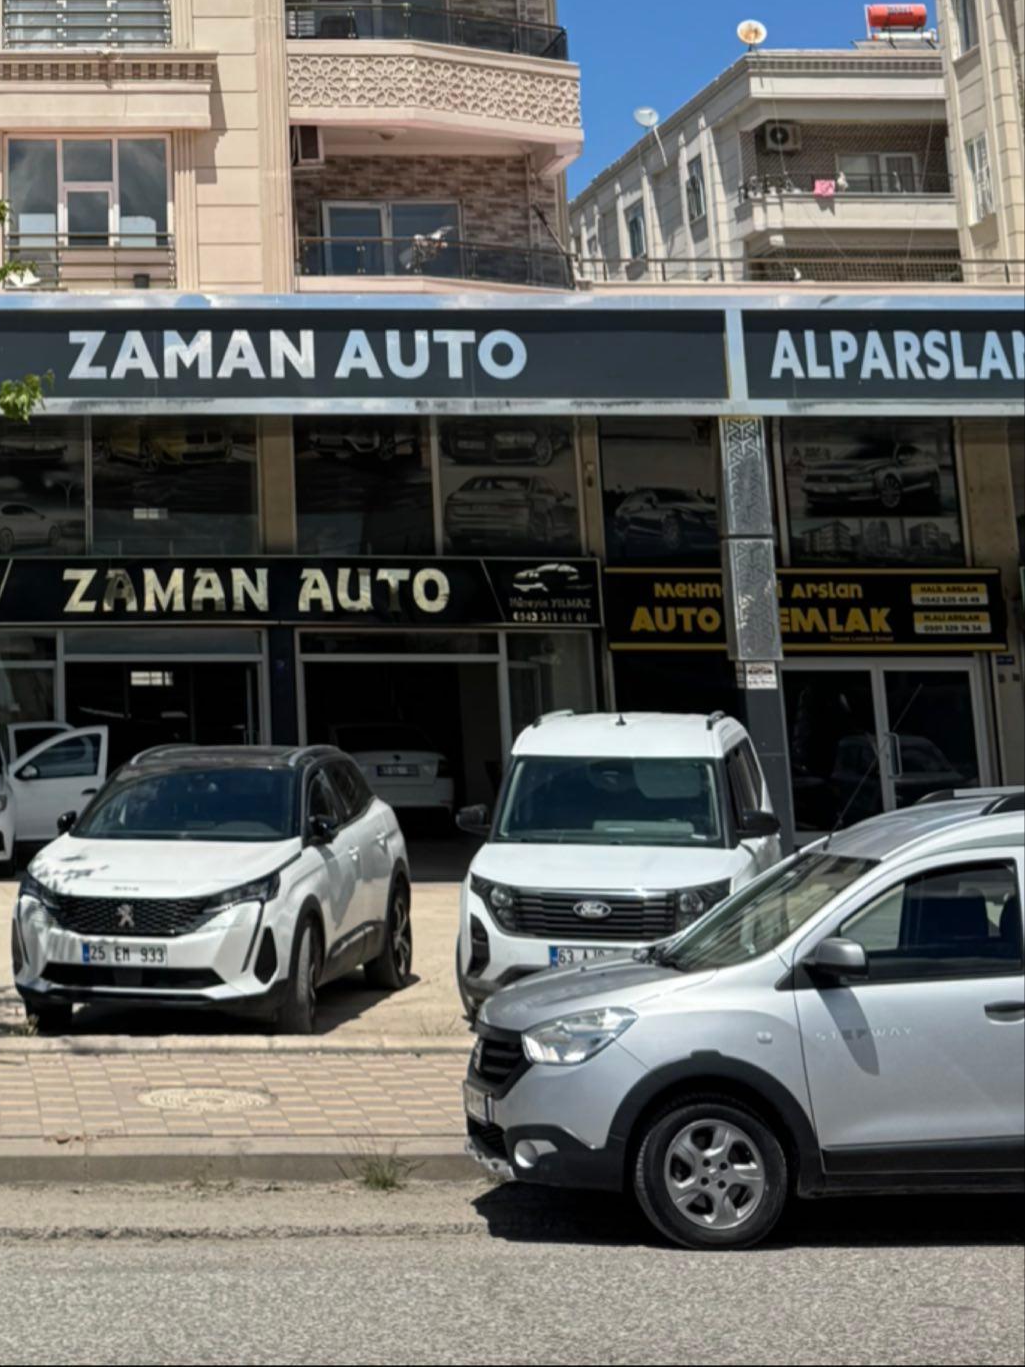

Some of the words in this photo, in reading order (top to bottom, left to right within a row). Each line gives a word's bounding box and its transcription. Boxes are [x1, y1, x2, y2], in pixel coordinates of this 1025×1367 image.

[68, 330, 316, 379] ZAMAN
[334, 329, 528, 380] AUTO
[62, 568, 269, 613] ZAMAN
[298, 568, 450, 612] AUTO
[630, 606, 721, 633] AUTO
[90, 945, 106, 961] 25
